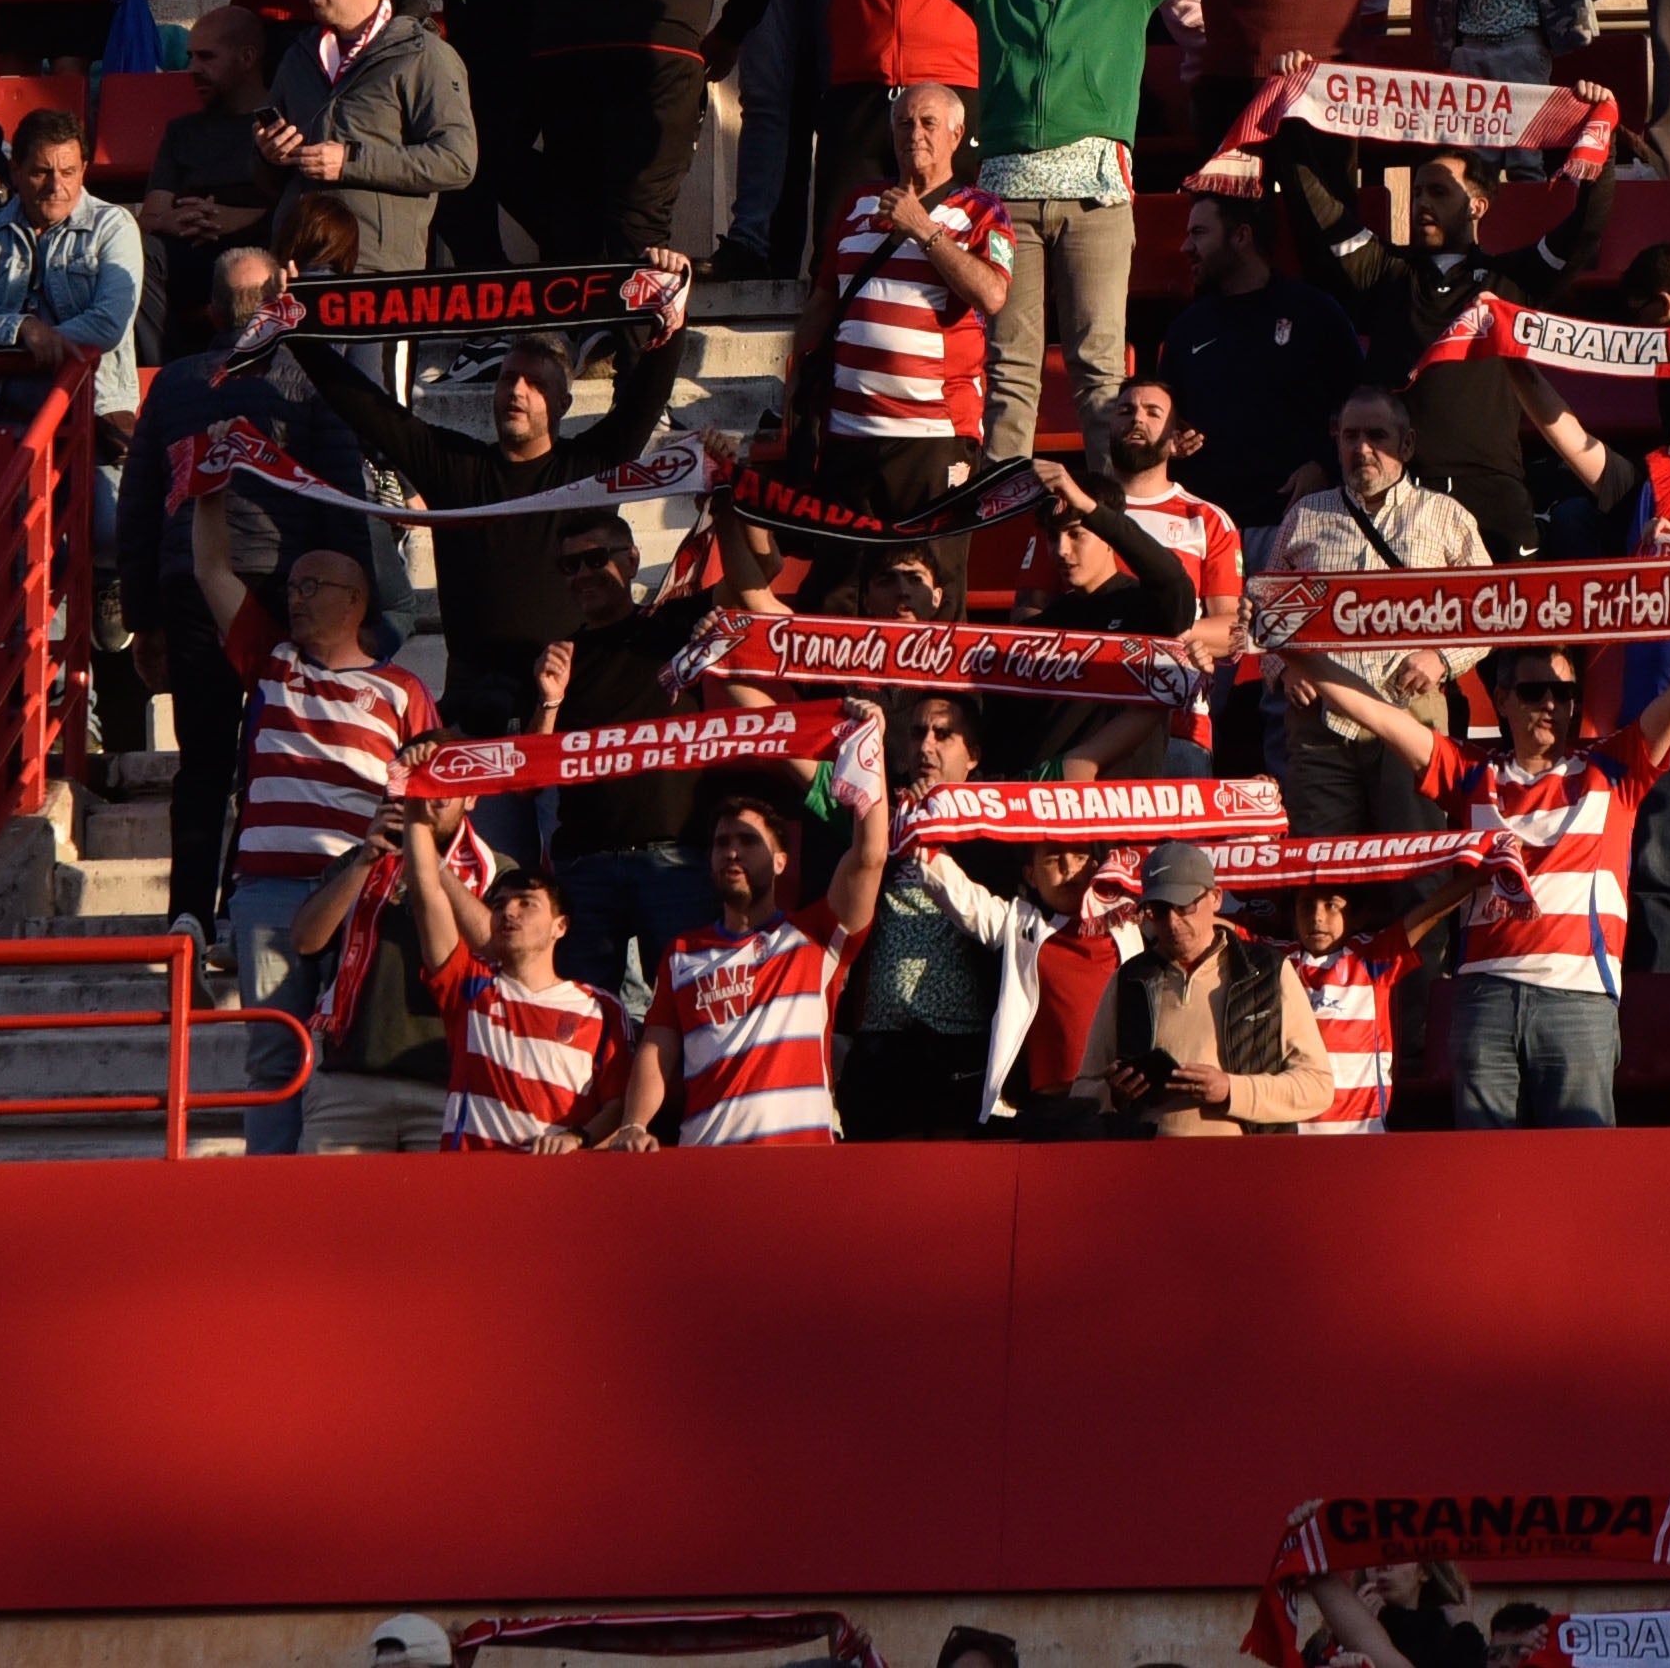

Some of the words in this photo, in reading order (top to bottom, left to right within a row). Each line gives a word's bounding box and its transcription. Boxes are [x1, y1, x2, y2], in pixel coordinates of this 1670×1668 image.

[1326, 74, 1514, 116] GRANADA
[1325, 105, 1379, 128] CLUB
[1394, 111, 1421, 131] DE
[1333, 589, 1463, 636] Granada
[1472, 584, 1529, 632] Club
[1537, 581, 1573, 627] de
[767, 617, 887, 675] Granada
[896, 624, 953, 674] Club
[961, 631, 994, 672] de
[562, 710, 798, 753] GRANADA
[560, 749, 634, 778] CLUB
[643, 747, 678, 772] DE
[1031, 782, 1205, 821] GRANADA
[1306, 832, 1484, 864] GRANADA
[1325, 1494, 1655, 1542] GRANADA
